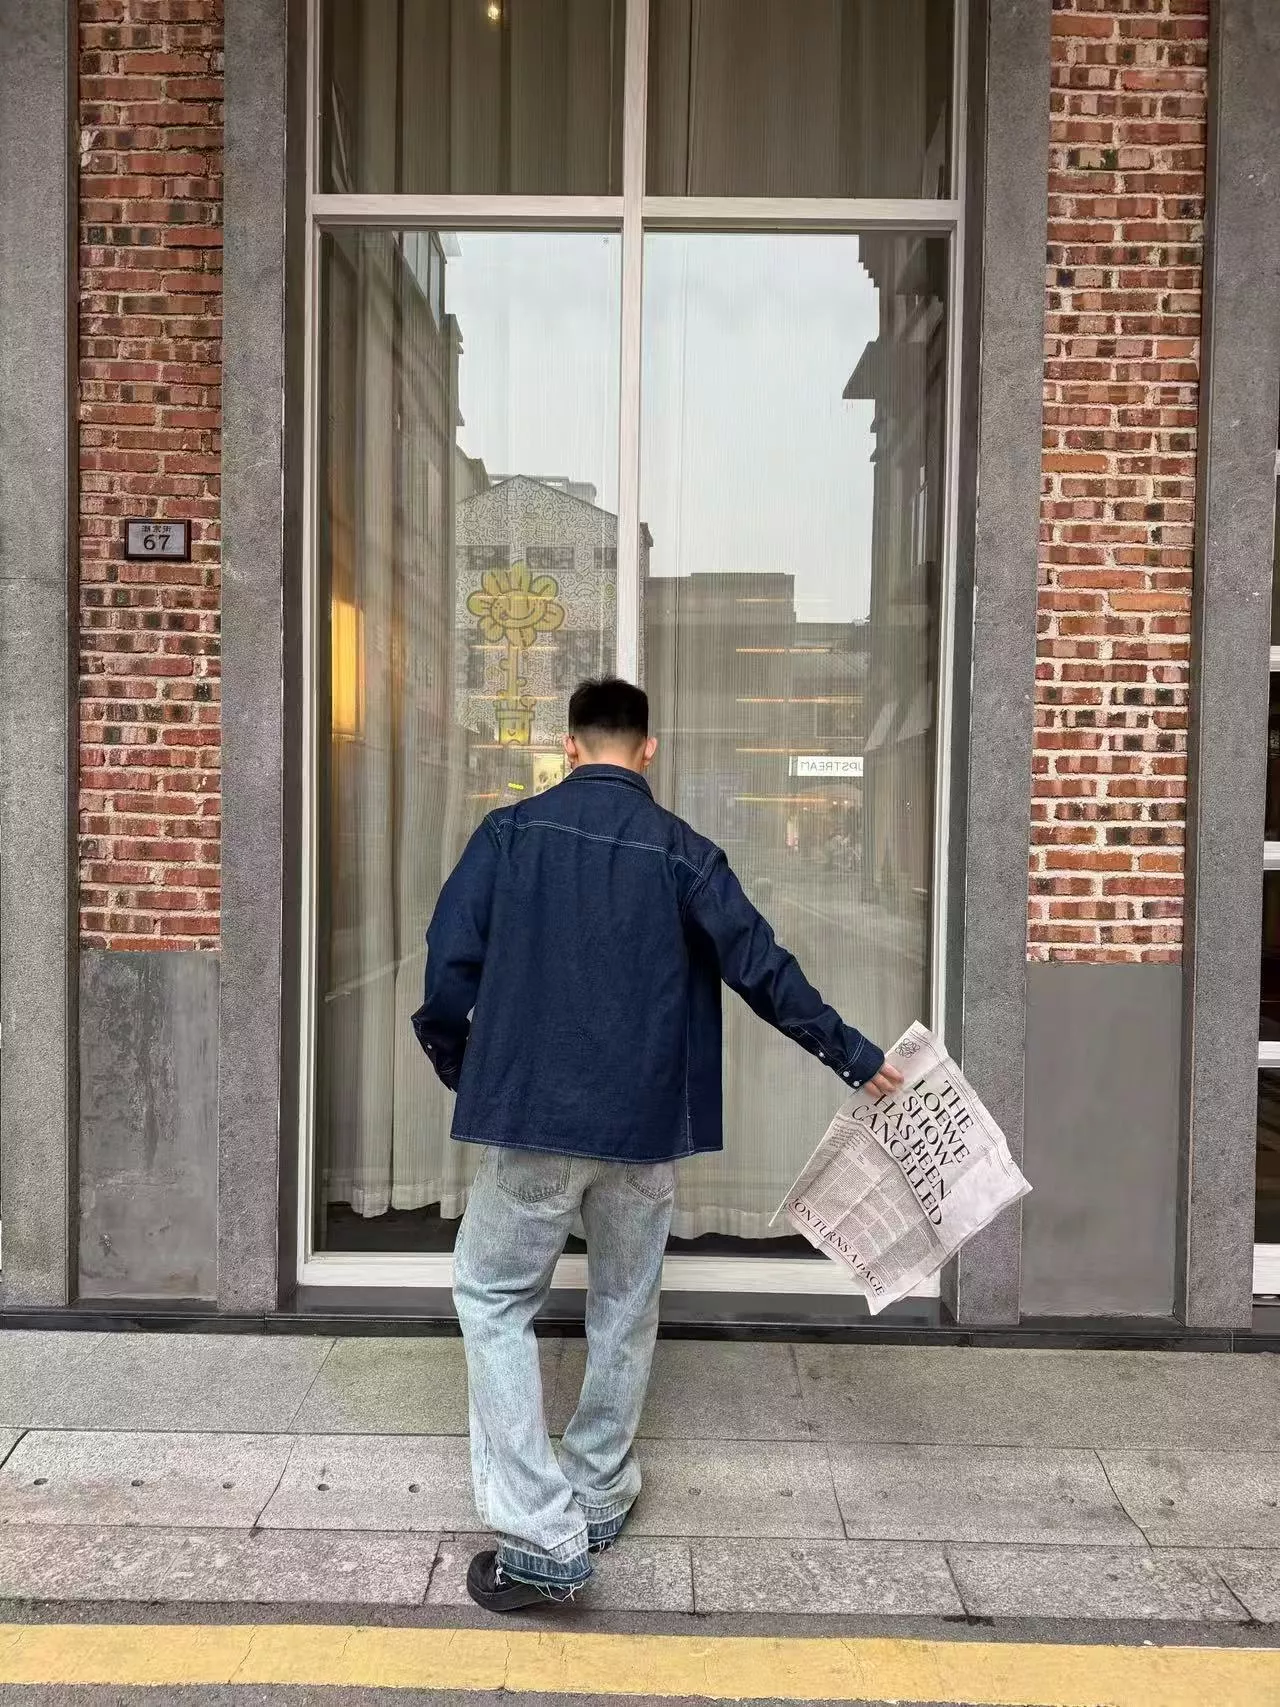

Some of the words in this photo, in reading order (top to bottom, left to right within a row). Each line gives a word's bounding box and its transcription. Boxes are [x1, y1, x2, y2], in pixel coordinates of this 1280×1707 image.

[143, 533, 171, 551] 67
[903, 1096, 954, 1168] SHOW
[913, 1079, 970, 1163] LOEWE
[938, 1080, 974, 1133] THE
[851, 1104, 944, 1226] CANCELLED
[873, 1093, 915, 1143] HAS
[911, 1139, 952, 1202] BEEN
[813, 1218, 851, 1252] TURNS
[847, 1254, 858, 1263] A
[856, 1262, 885, 1296] PAGE
